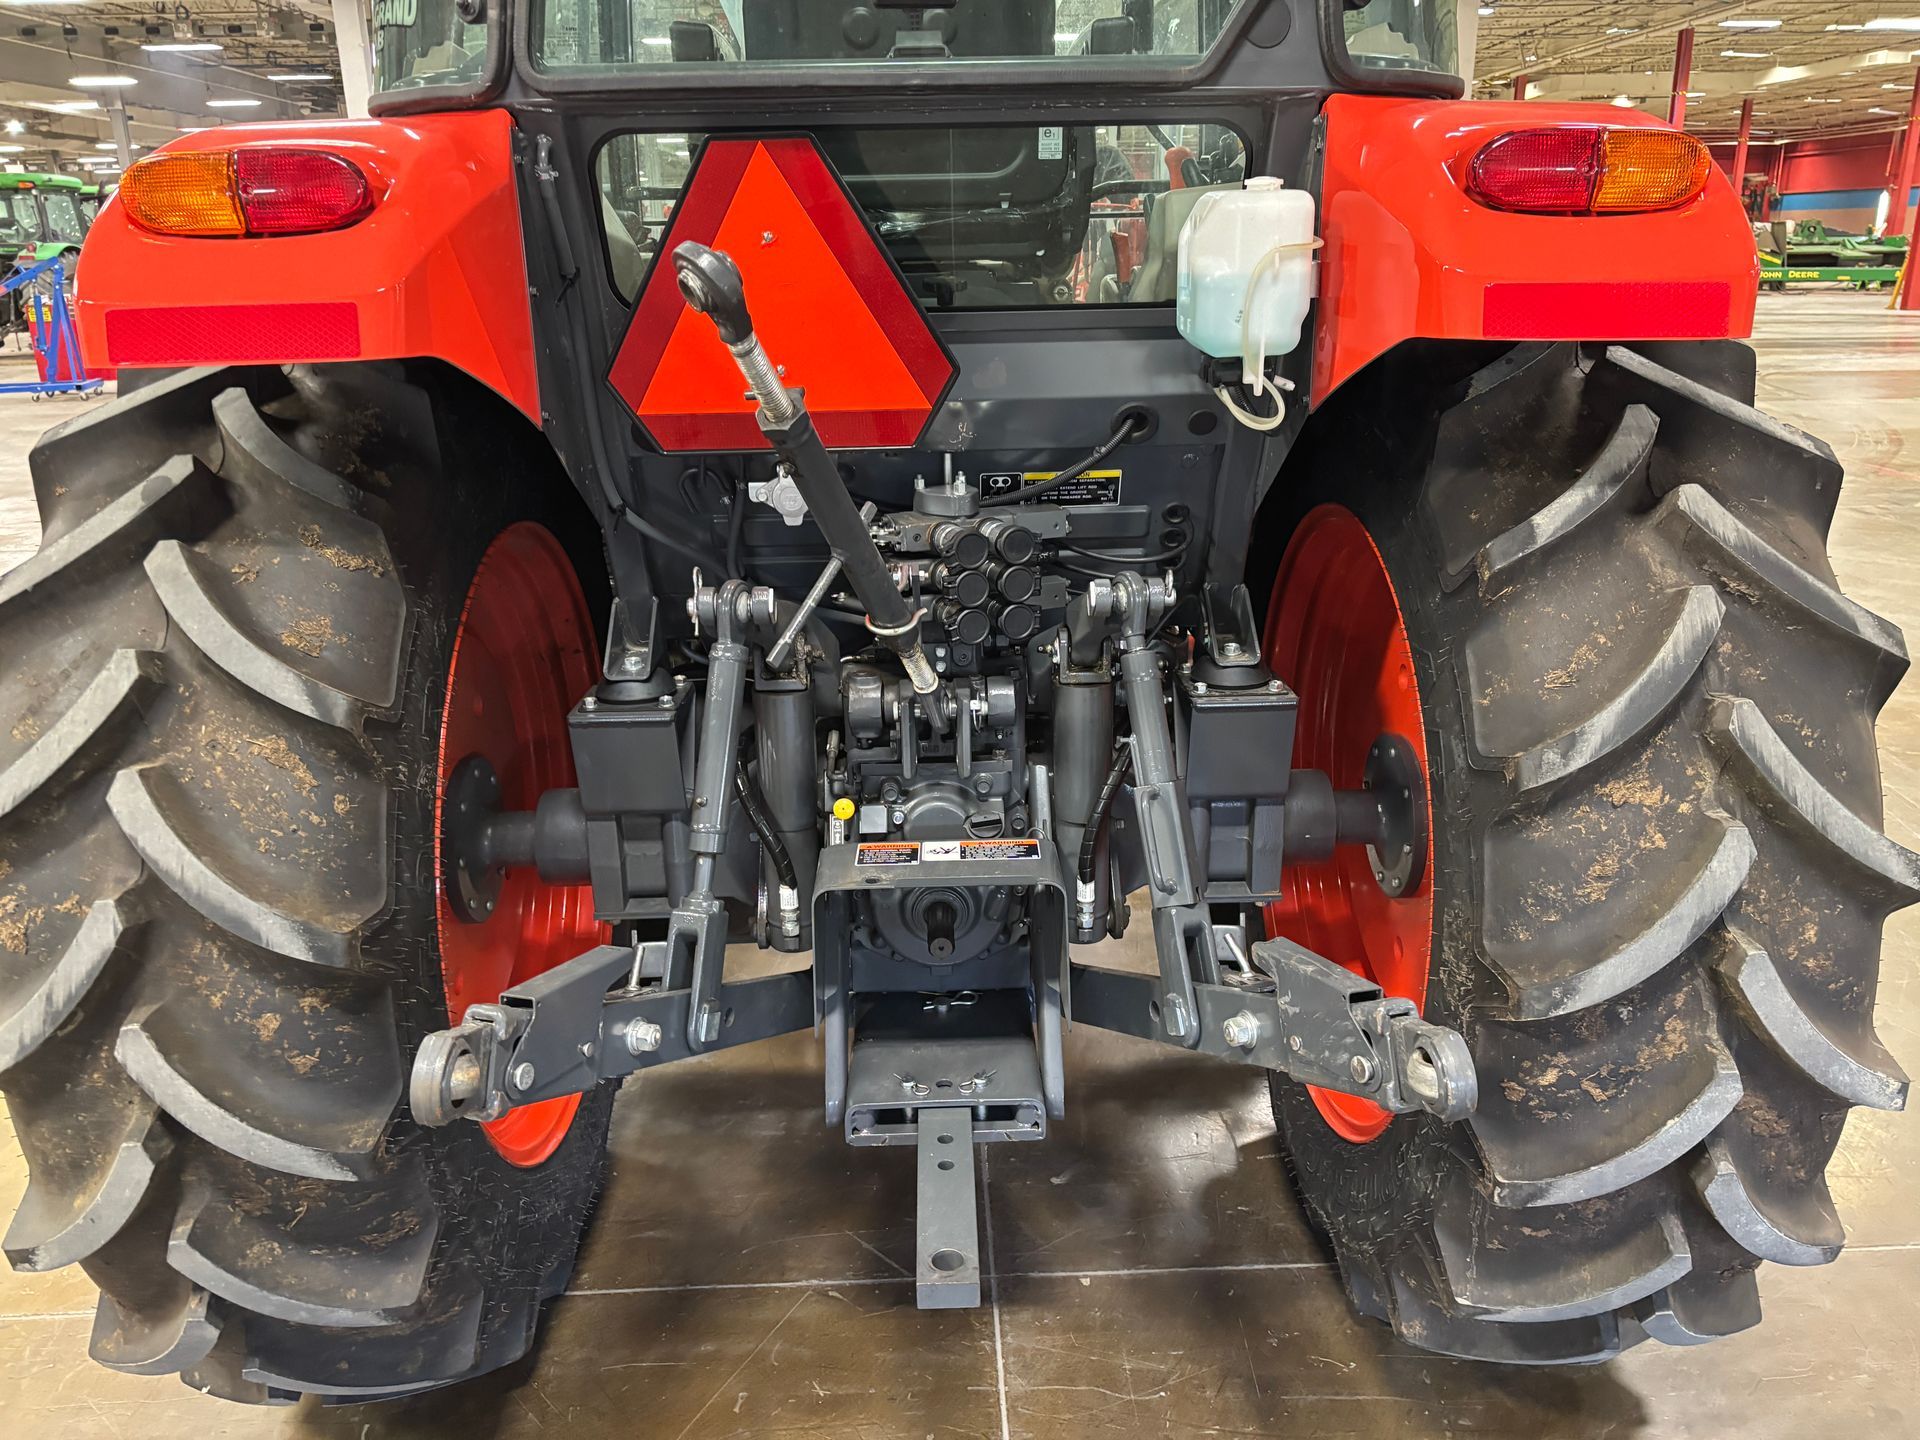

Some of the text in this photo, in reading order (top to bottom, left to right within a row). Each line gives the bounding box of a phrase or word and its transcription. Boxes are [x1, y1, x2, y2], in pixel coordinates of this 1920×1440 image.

[375, 0, 418, 28] GRAND
[1760, 270, 1820, 279] JOHN DEERE
